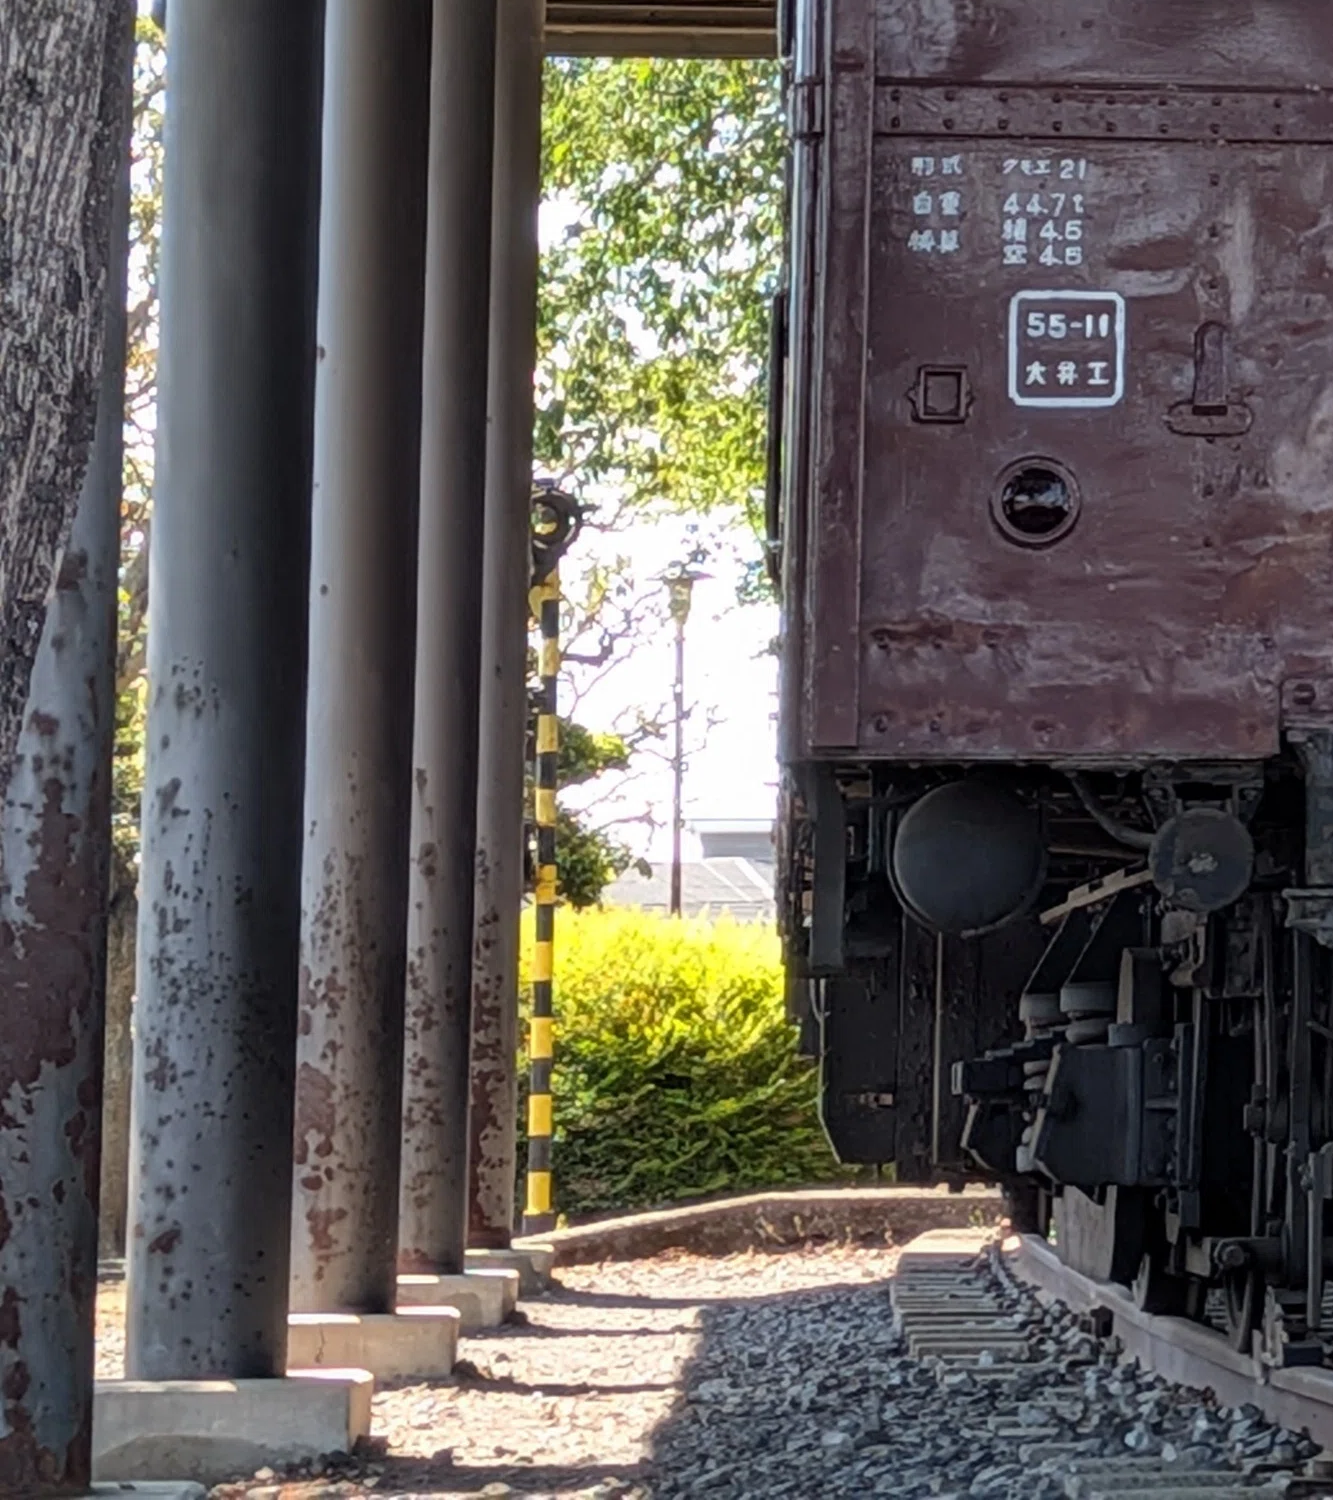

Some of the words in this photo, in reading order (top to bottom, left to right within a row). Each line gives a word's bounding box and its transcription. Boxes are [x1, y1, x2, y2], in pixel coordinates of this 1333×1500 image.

[1026, 312, 1110, 339] 55-11
[1025, 360, 1110, 386] 大井工
